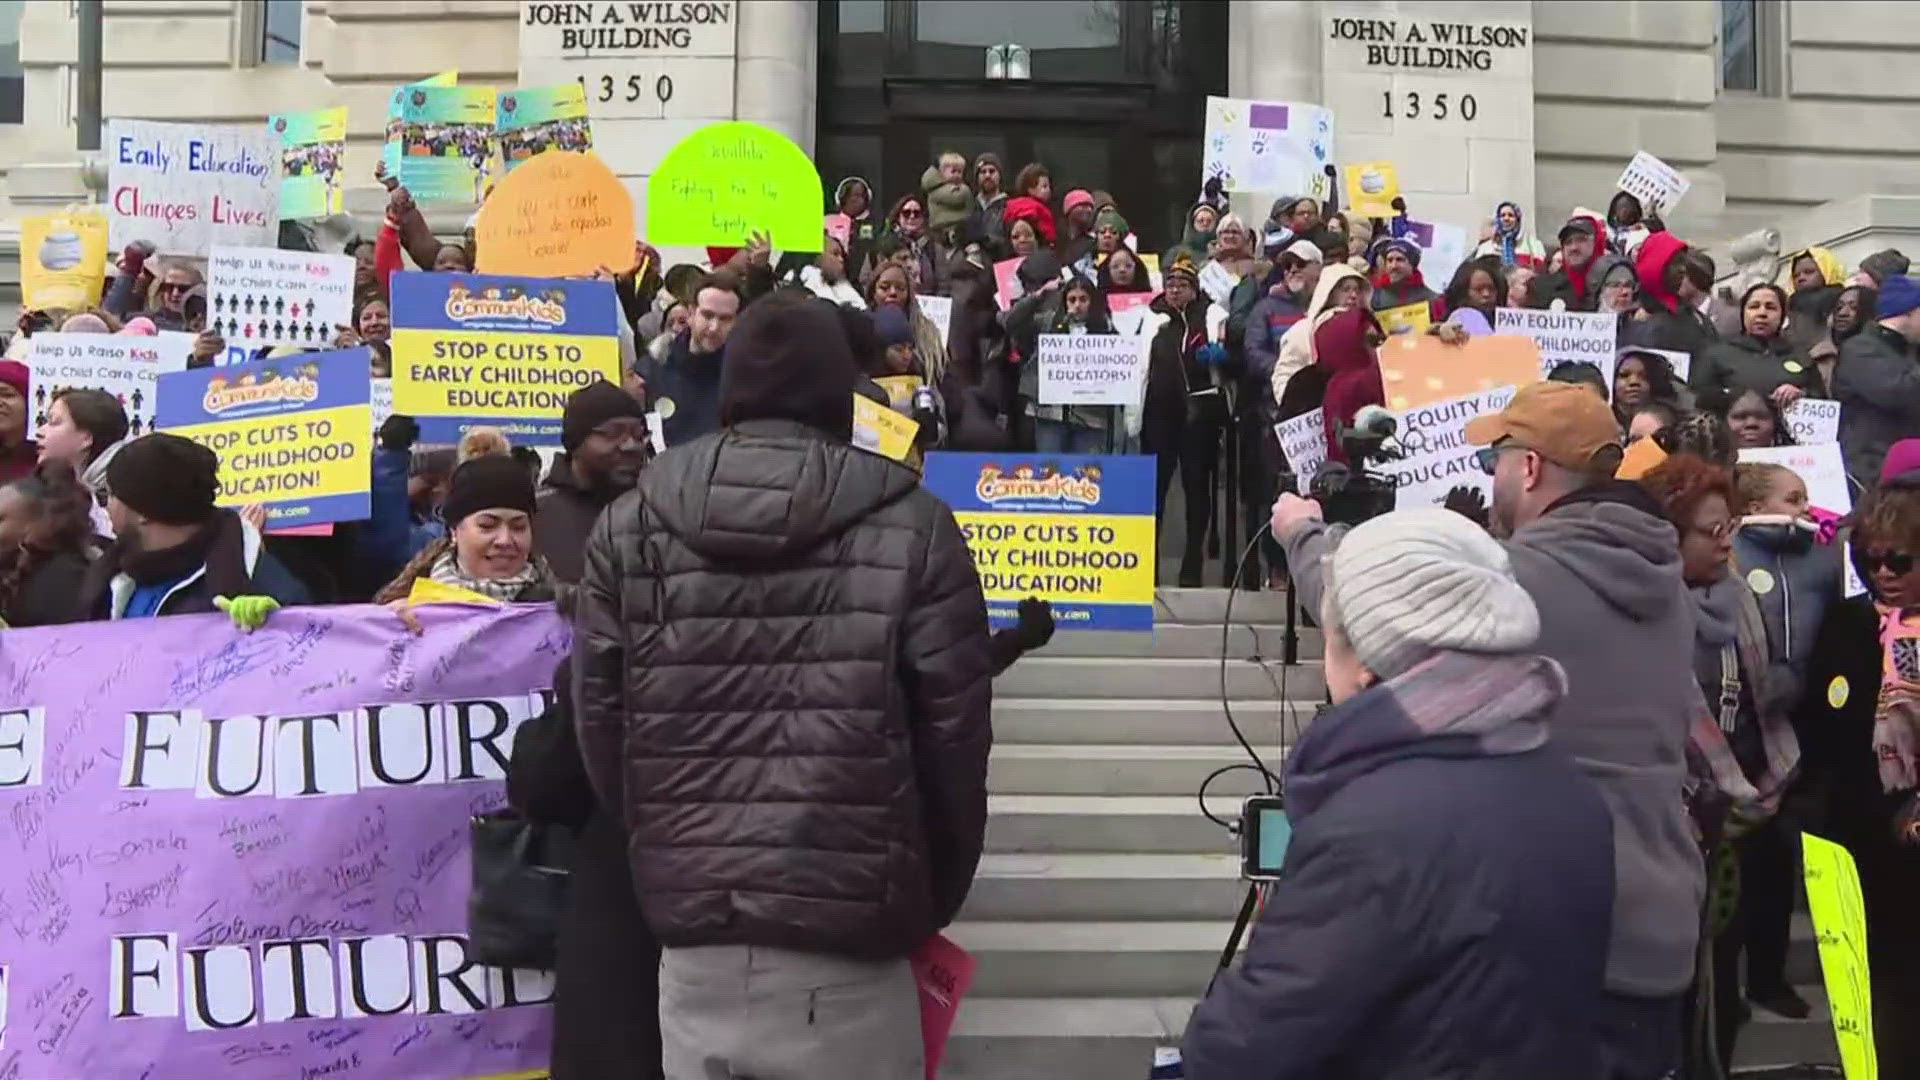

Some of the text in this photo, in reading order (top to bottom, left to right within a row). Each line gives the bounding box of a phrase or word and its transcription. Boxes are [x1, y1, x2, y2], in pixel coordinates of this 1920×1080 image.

[526, 3, 593, 26] JOHN
[630, 2, 730, 25] WILSON
[562, 27, 692, 50] BUILDING
[1331, 17, 1396, 42] JOHN
[1431, 23, 1528, 48] WILSON
[1366, 45, 1492, 71] BUILDING
[1382, 91, 1477, 121] 1350
[119, 137, 269, 188] Early Education
[114, 185, 267, 231] Changes Lives
[1498, 311, 1524, 327] PAY
[1527, 312, 1586, 330] EQUITY
[433, 340, 582, 363] STOP CUTS TO
[1040, 337, 1065, 349] PAY
[129, 349, 159, 362] Kids
[61, 366, 93, 378] Child
[410, 364, 605, 387] EARLY CHILDHOOD
[1405, 396, 1480, 431] EQUITY
[1802, 403, 1837, 419] PAGO
[246, 424, 298, 446] CUTS
[304, 419, 332, 438] TO
[231, 442, 355, 472] CHILDHOOD
[961, 523, 1115, 544] STOP CUTS TO
[1007, 549, 1138, 569] CHILDHOOD
